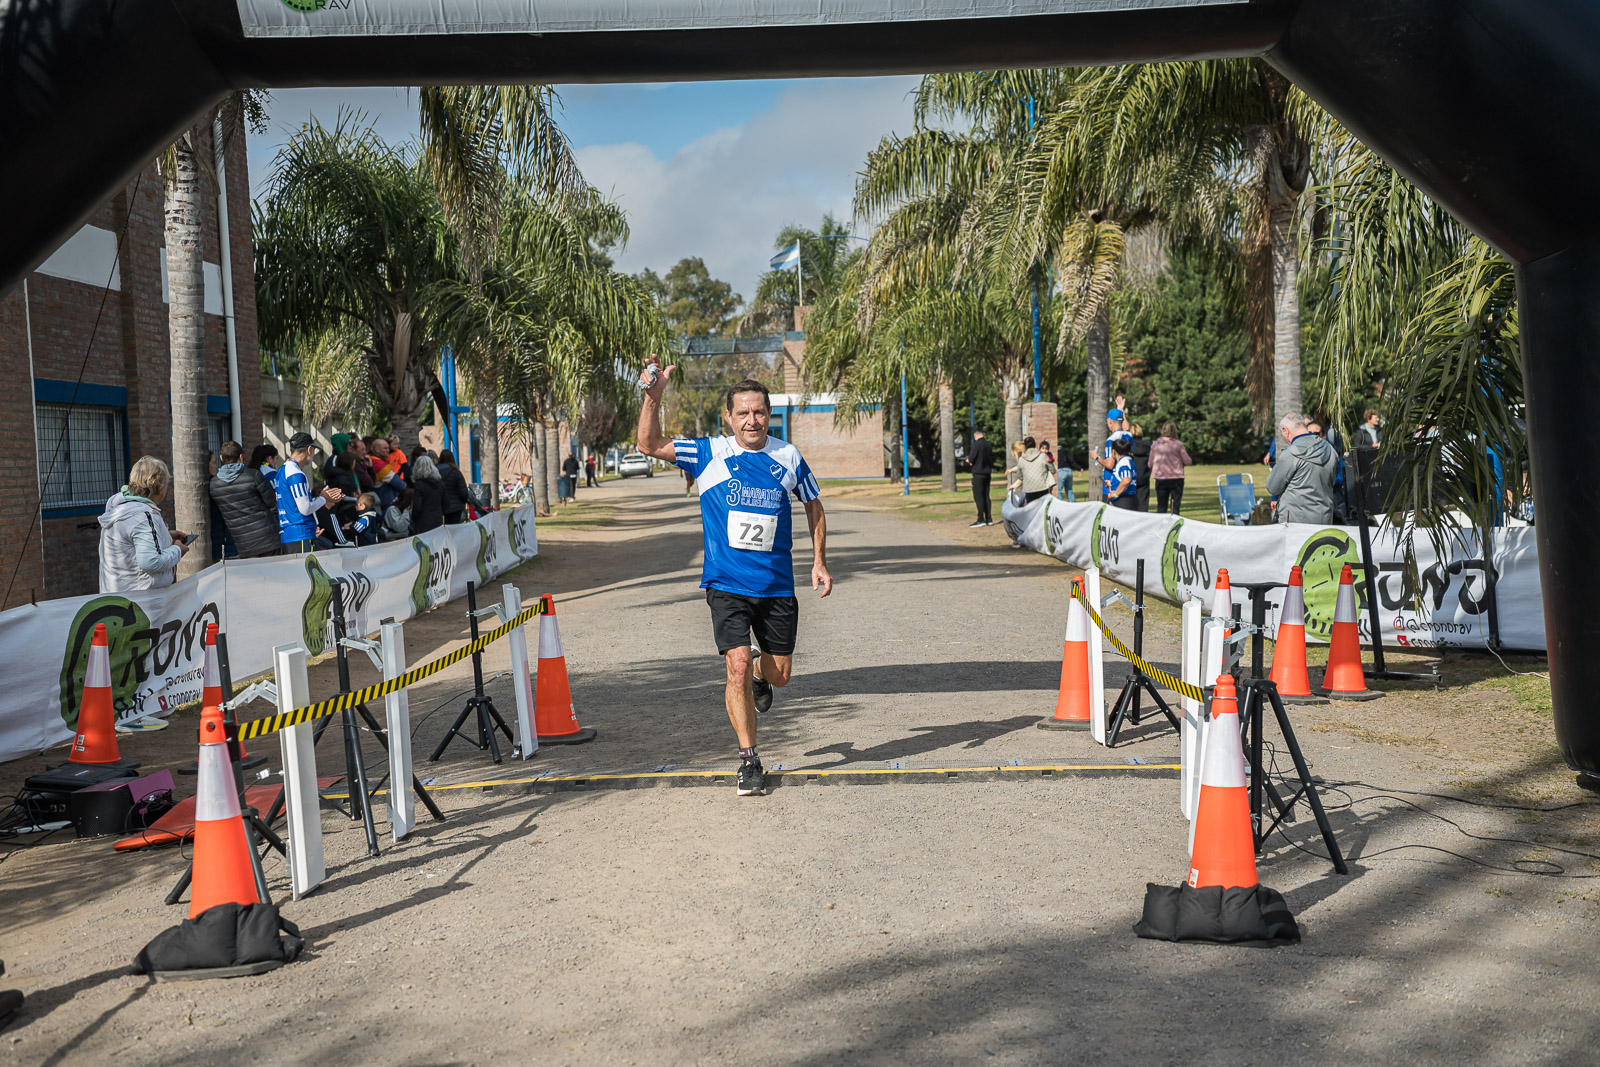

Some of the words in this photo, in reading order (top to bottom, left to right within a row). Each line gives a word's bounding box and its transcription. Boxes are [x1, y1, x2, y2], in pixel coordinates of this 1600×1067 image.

[315, 0, 351, 10] RAV
[726, 478, 742, 506] 3
[740, 522, 764, 543] 72
[1406, 618, 1472, 634] @cronorav
